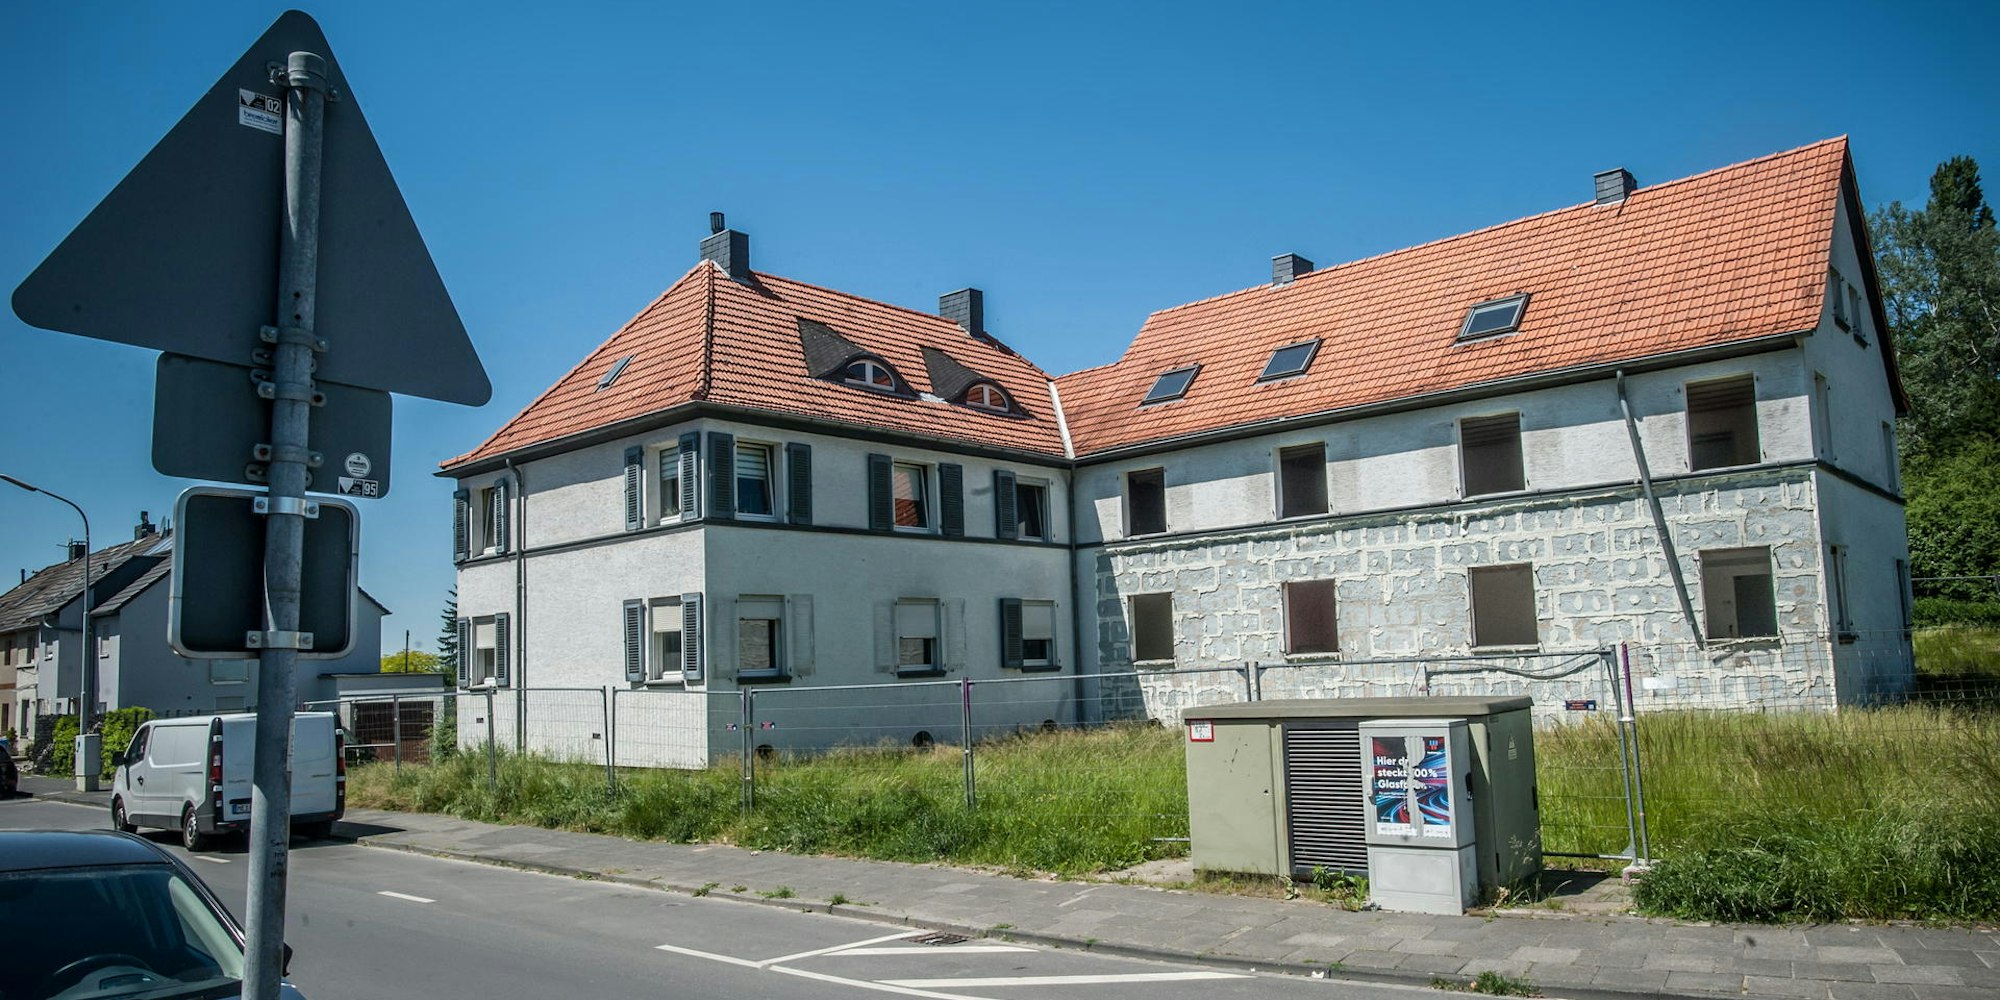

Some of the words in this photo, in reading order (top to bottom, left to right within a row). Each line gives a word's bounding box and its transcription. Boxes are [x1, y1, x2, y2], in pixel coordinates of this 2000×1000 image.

[267, 99, 279, 112] 02
[364, 482, 376, 495] 95
[1377, 756, 1396, 765] Hier
[1378, 768, 1407, 776] steckt
[1413, 768, 1437, 777] 00%
